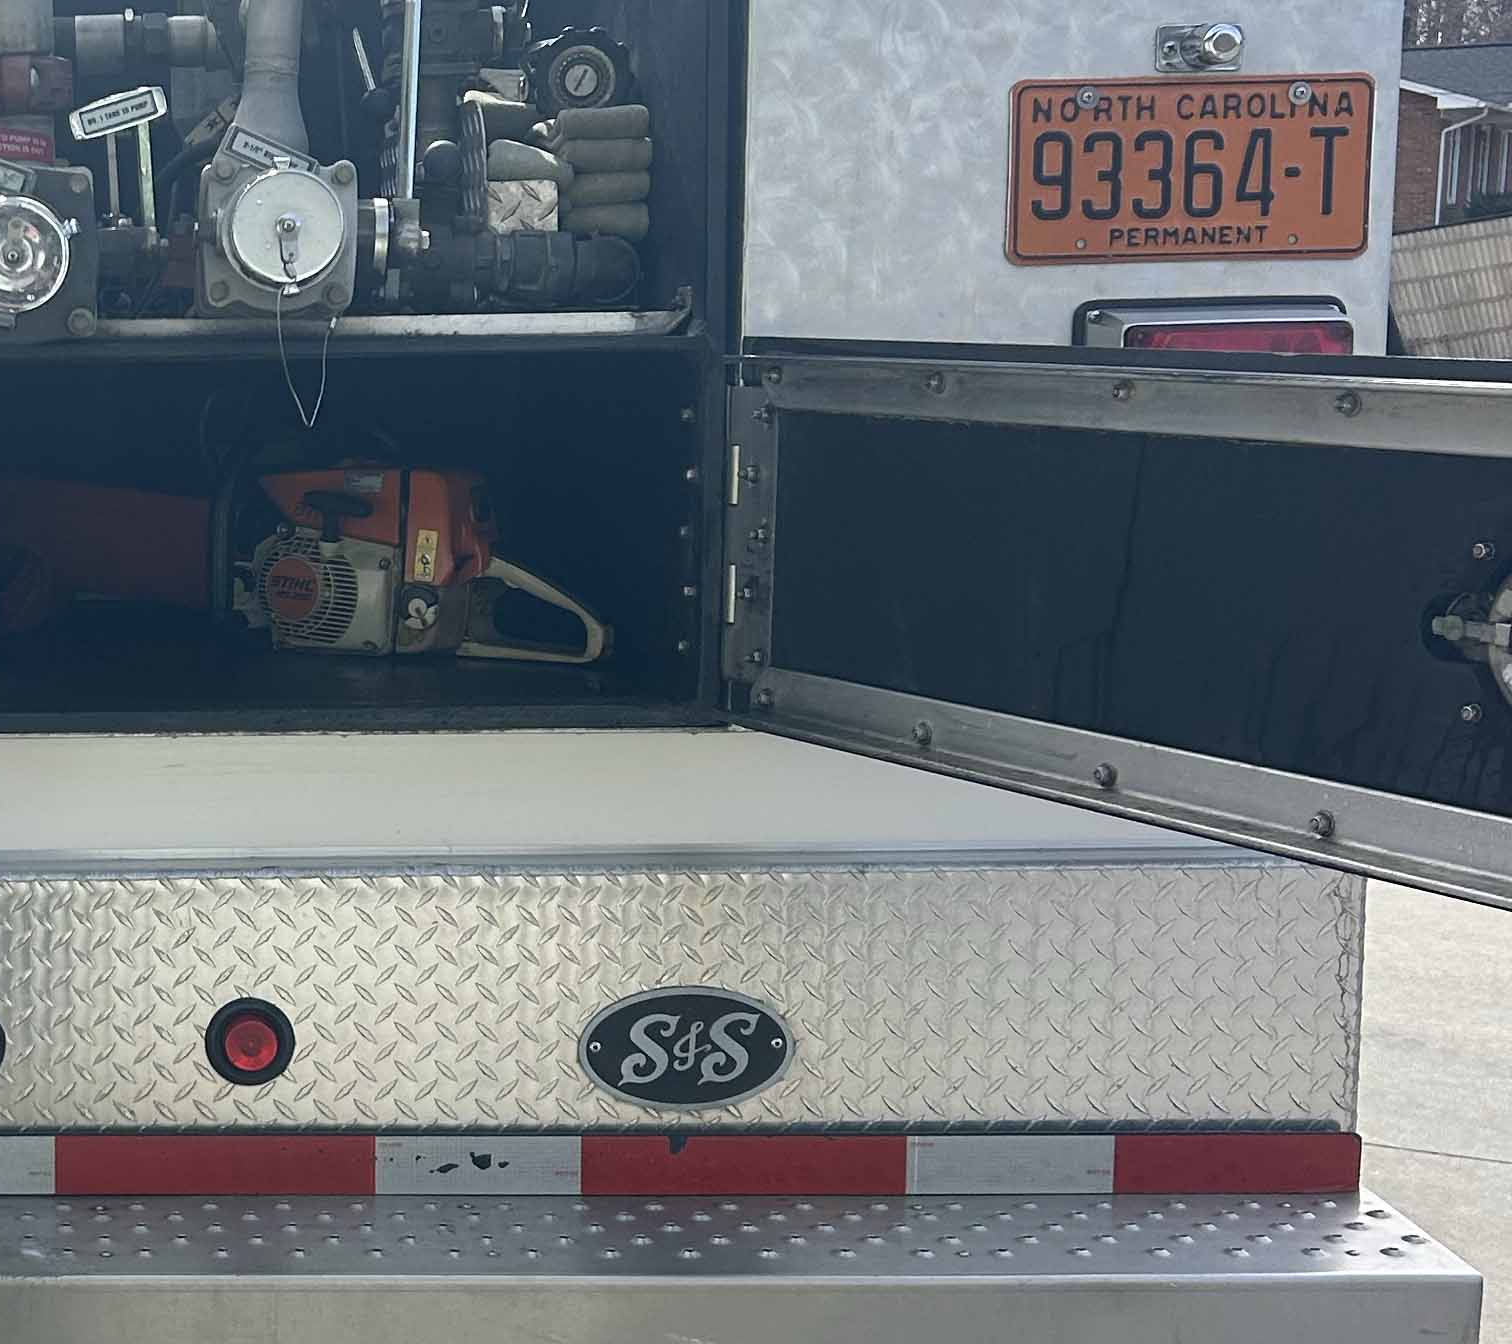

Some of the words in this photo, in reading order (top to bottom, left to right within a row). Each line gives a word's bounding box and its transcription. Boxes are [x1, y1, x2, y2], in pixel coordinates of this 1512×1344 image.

[104, 109, 120, 120] TANK
[121, 106, 130, 115] TO
[131, 100, 148, 112] PUMP
[1031, 96, 1156, 123] NORTH
[1176, 92, 1354, 119] CAROLINA
[10, 135, 31, 144] PUMP
[1031, 126, 1349, 221] 93364-T
[1108, 225, 1269, 248] PERMANENT
[272, 575, 313, 591] STIHL
[617, 1012, 761, 1087] S&S
